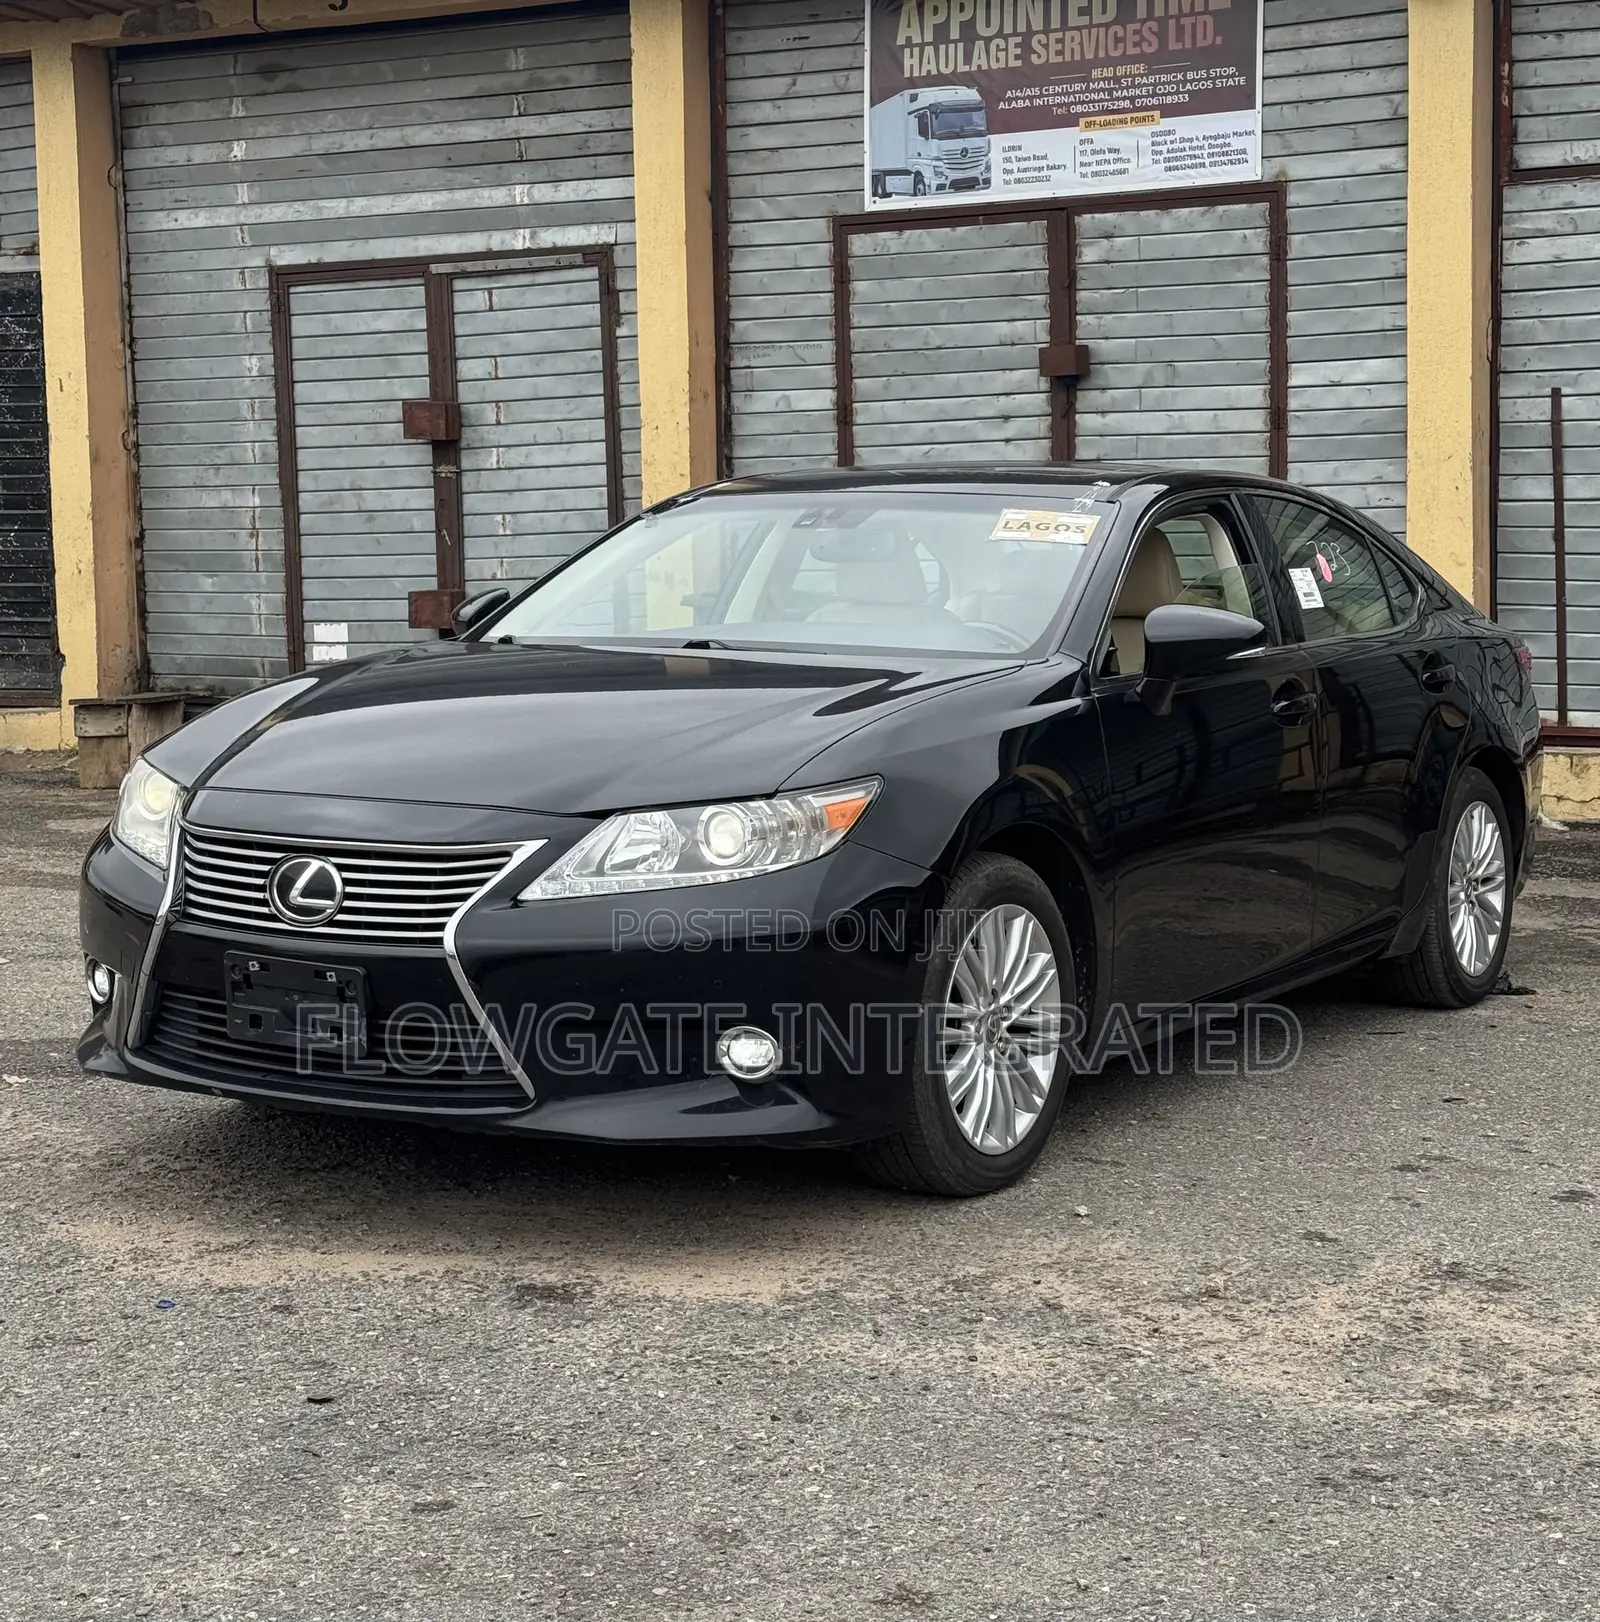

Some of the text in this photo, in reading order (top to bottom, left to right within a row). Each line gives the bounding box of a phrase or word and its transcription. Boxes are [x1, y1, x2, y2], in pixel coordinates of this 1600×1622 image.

[903, 14, 1223, 78] HAULAGE SERVICES LTD.
[1091, 63, 1148, 79] HEAD OFFICE:
[1005, 66, 1239, 99] A14/A15 CENTURY MALL, ST PARTRICK BUS STOP,
[998, 76, 1247, 110] ALABA INTERNATIONAL MARKET OJO LAGOS STATE
[1052, 93, 1190, 116] Tel: 08033175298, 0706118933
[1084, 114, 1156, 129] OFF-LOADING POINTS
[1079, 137, 1094, 146] OFFA
[1151, 138, 1168, 147] Block
[1178, 136, 1194, 145] Shop
[1002, 144, 1023, 153] ILORIN
[1151, 148, 1165, 157] Opp.
[1015, 155, 1032, 163] Taiwo
[1079, 160, 1094, 168] Near
[1095, 158, 1112, 167] NEPA
[1002, 167, 1016, 176] Opp.
[1002, 520, 1088, 534] LAGOS
